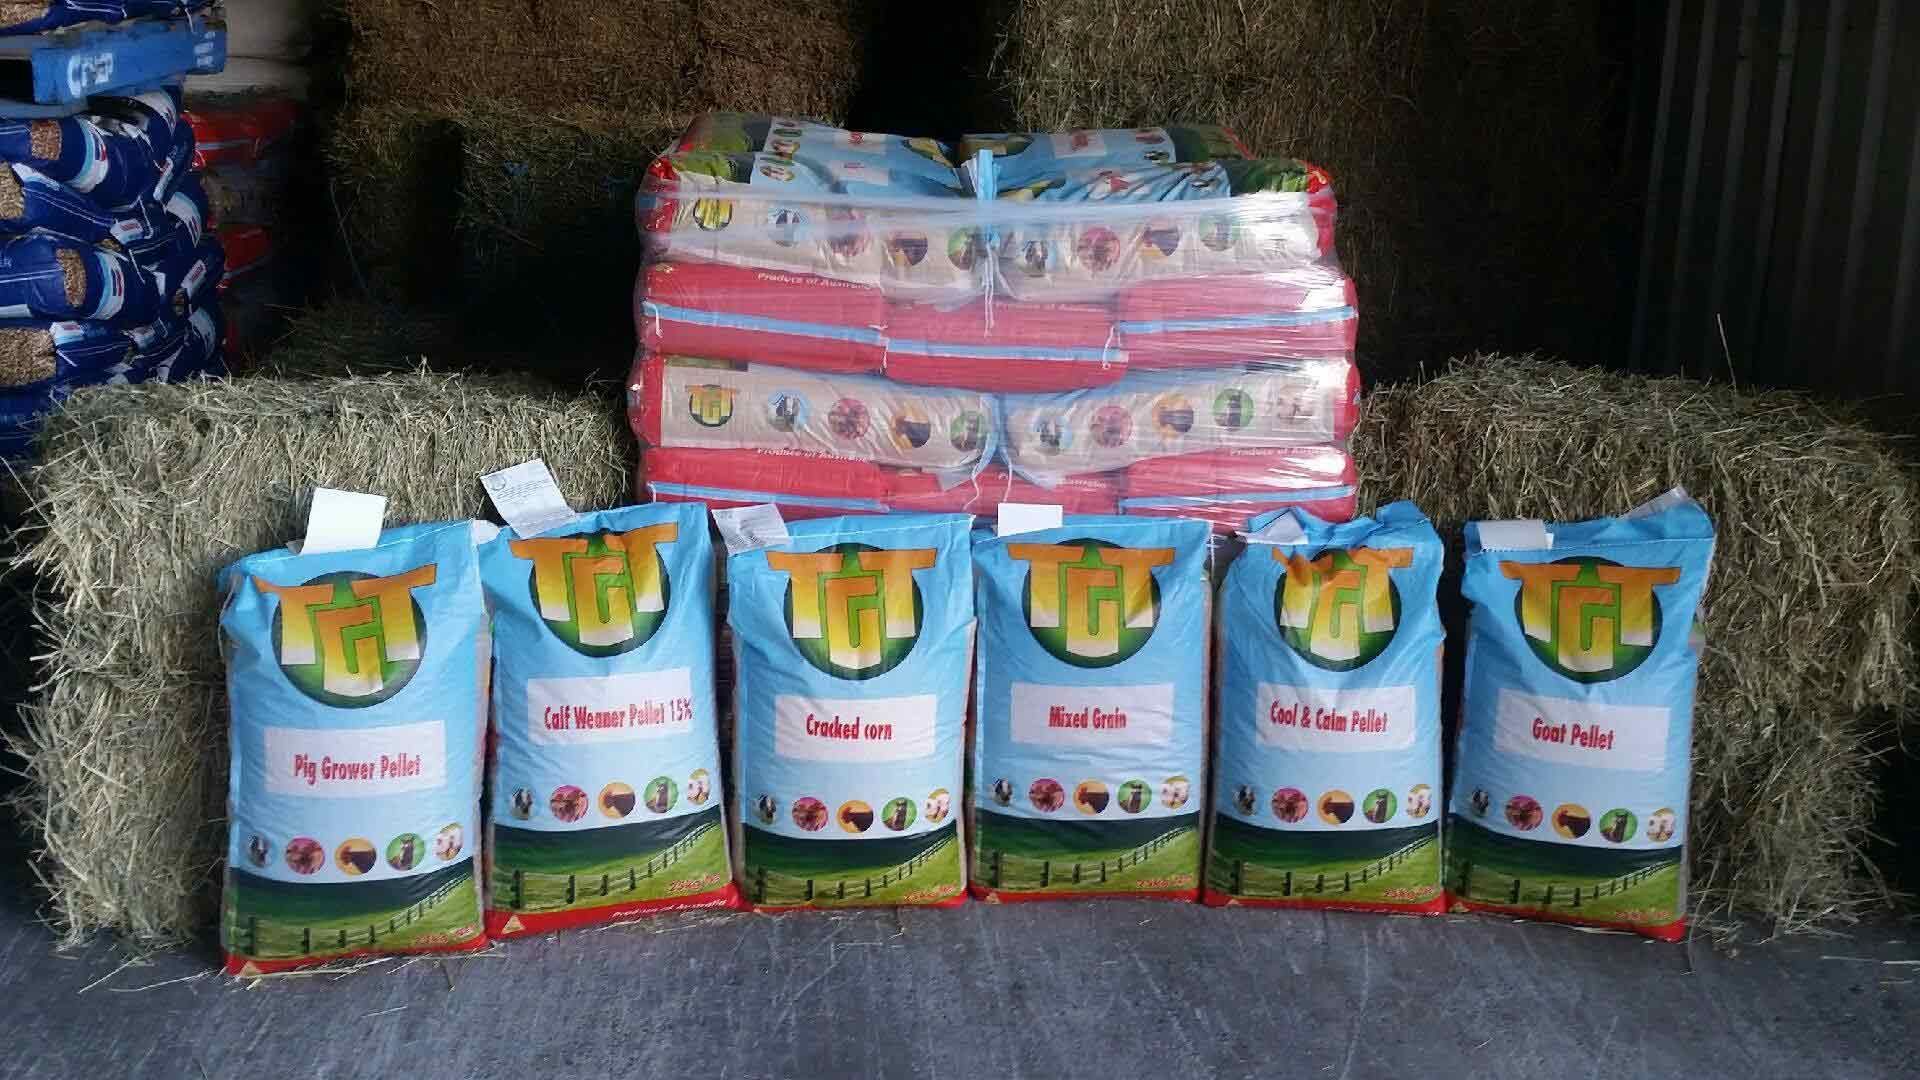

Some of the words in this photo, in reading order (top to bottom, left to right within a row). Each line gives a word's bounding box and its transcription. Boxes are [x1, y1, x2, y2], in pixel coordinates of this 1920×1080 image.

[510, 522, 678, 646] TGT
[1007, 543, 1177, 658] TGT
[766, 549, 937, 669] TGT
[1498, 560, 1682, 673] TGT
[253, 563, 438, 697] TGT
[544, 704, 570, 730] Calf
[573, 704, 626, 730] Weaner
[629, 699, 665, 728] Pellet
[670, 696, 694, 722] 15%
[806, 713, 860, 740] Cracked
[864, 722, 892, 740] corn
[1048, 705, 1089, 728] Mixed
[1092, 706, 1127, 729] Grain
[1270, 700, 1298, 727] Cool
[1300, 705, 1311, 729] &
[1316, 706, 1348, 732] Calm
[1351, 708, 1388, 733] Pellet
[1532, 717, 1567, 743] Goat
[1570, 722, 1614, 750] Pellet
[294, 753, 317, 786] Pig
[321, 755, 376, 780] Grower
[380, 752, 421, 778] Pellet
